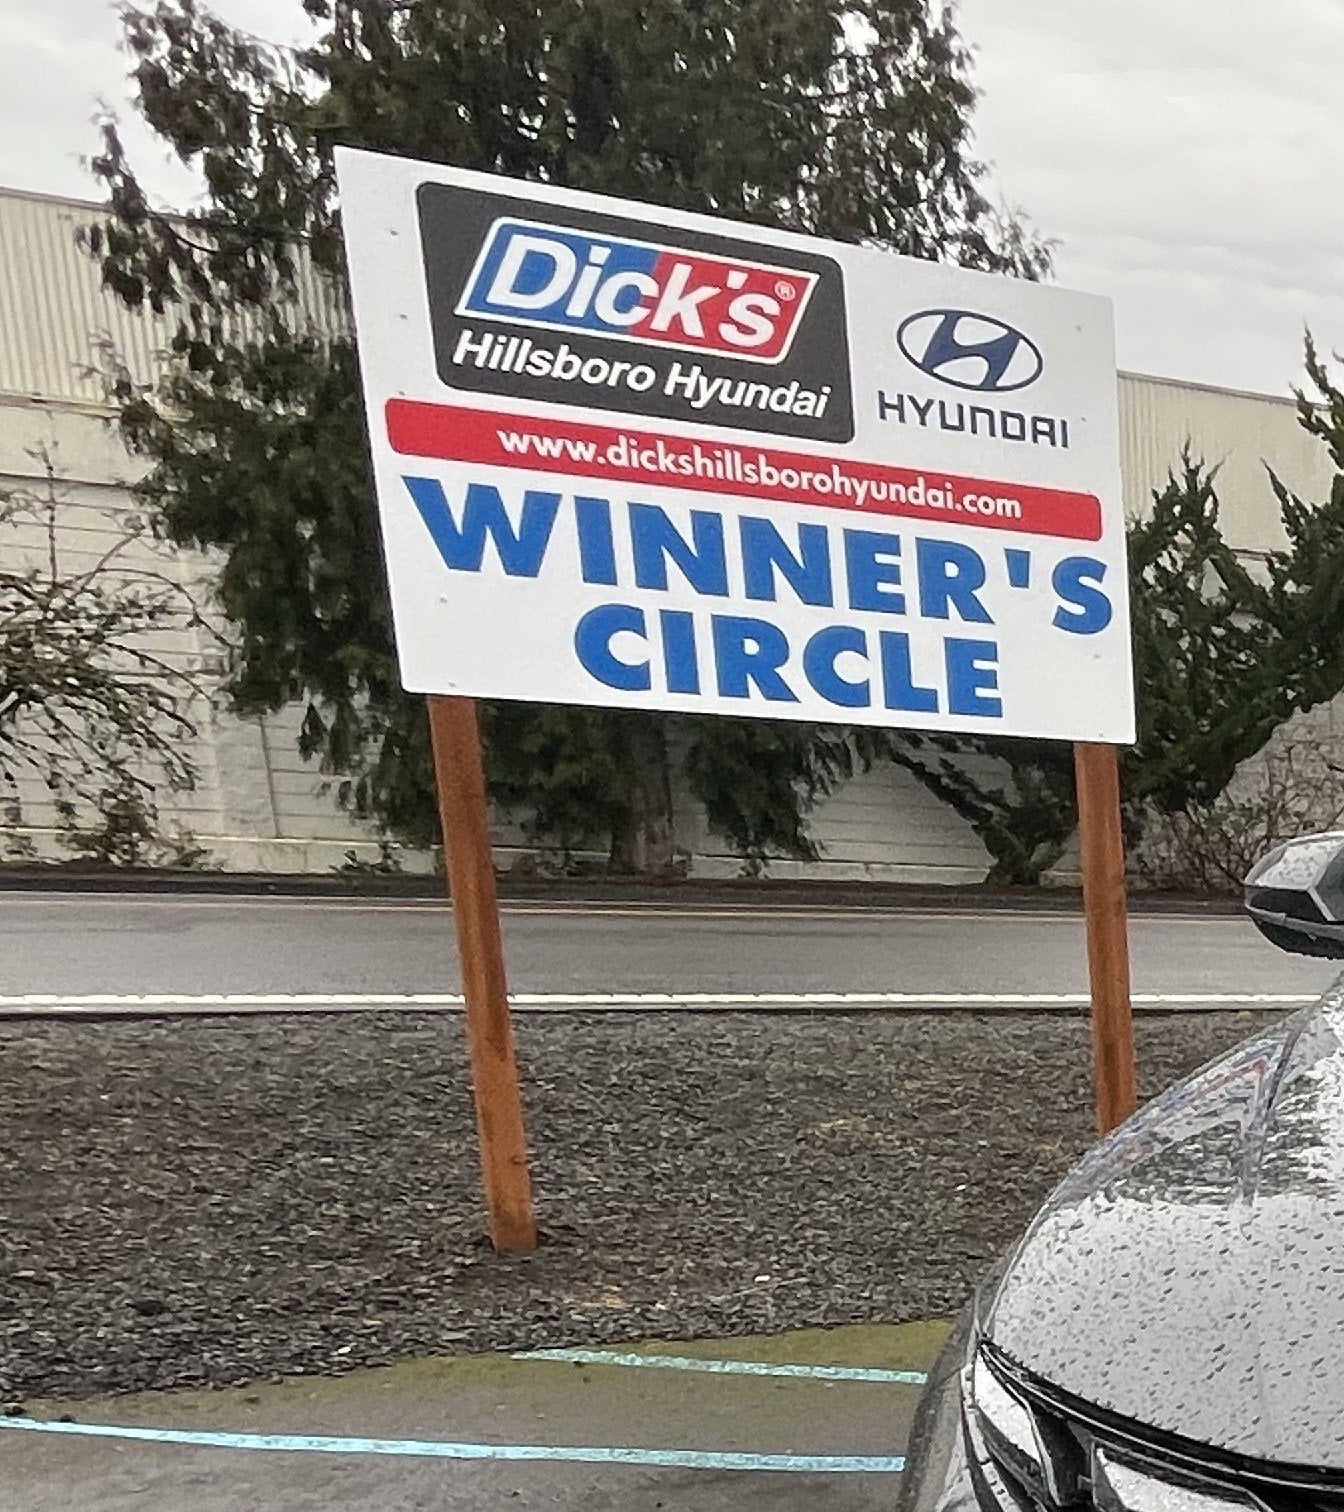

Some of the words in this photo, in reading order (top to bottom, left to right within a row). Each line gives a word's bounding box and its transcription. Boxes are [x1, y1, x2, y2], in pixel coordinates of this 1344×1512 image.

[451, 328, 657, 392] Hillsboro
[663, 360, 832, 419] Hyundai
[877, 390, 1070, 449] HYUNDAI
[496, 429, 1022, 519] www.dickshillsborohyundai.com
[400, 475, 1114, 635] WINNER'S
[573, 603, 1004, 719] CIRCLE
